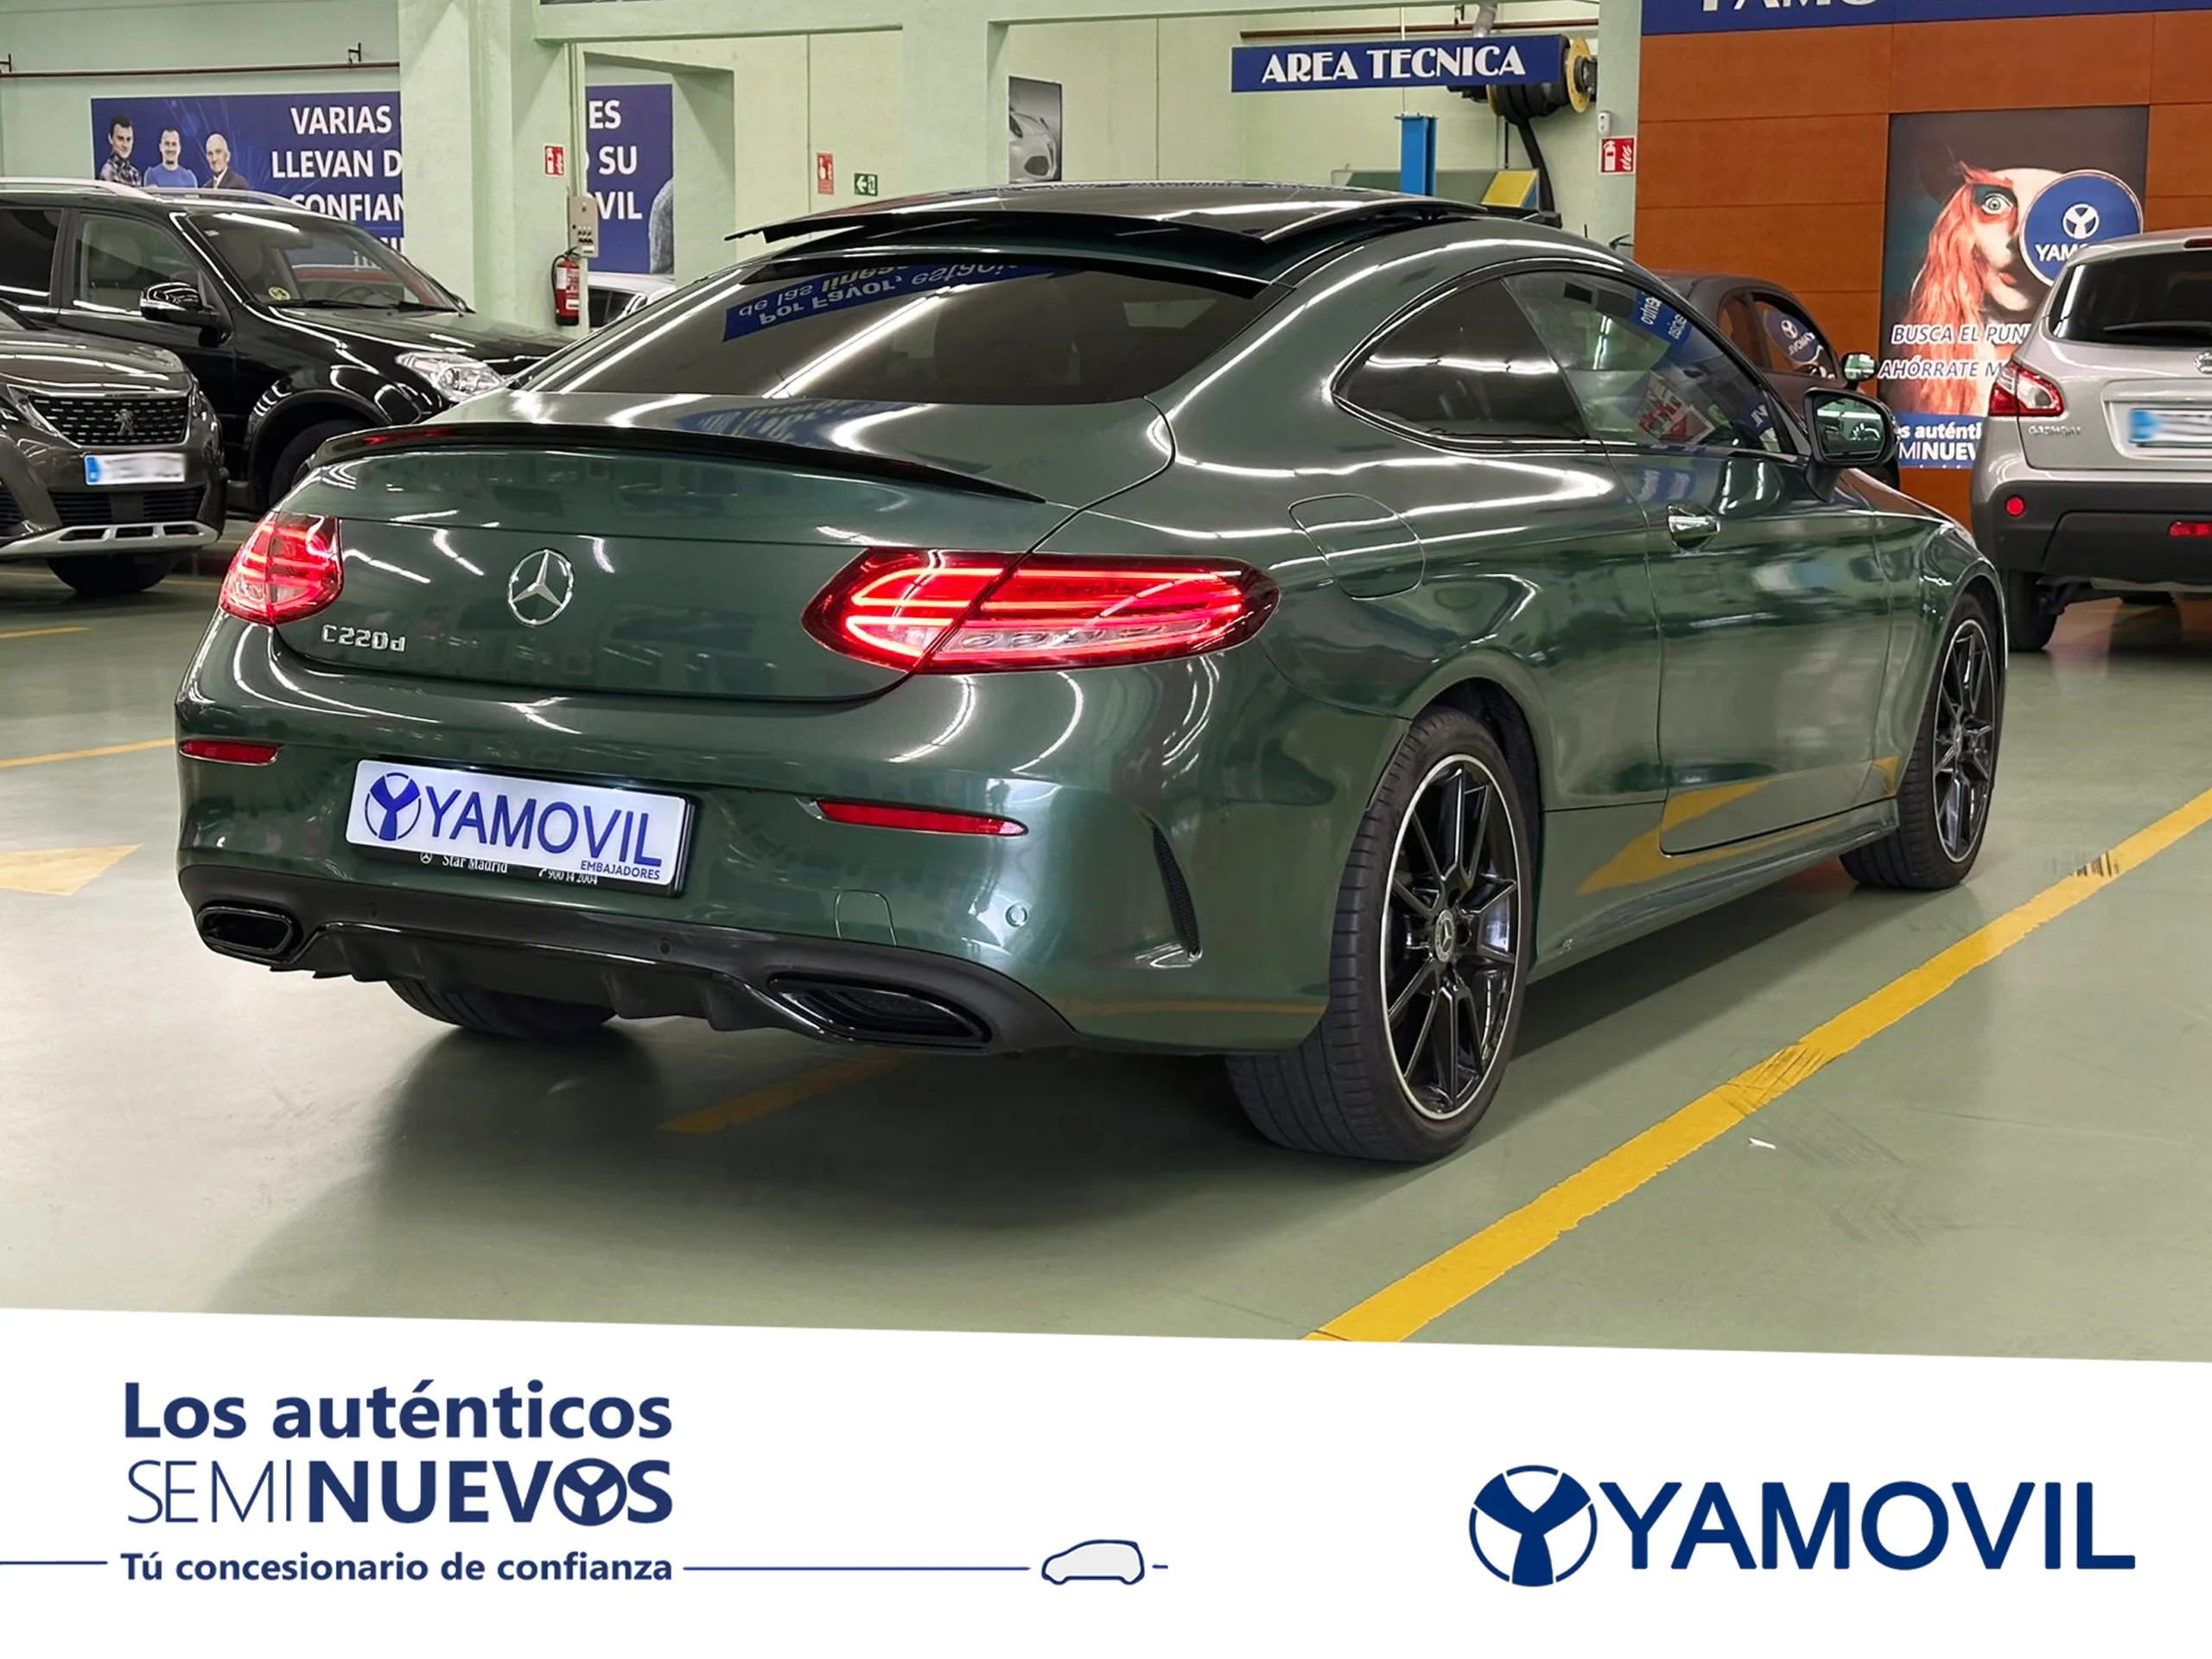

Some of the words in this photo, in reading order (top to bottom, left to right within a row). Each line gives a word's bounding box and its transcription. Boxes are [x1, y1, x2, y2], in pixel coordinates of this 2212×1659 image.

[1262, 51, 1358, 84] AREA
[1367, 45, 1525, 79] TECNICA
[290, 105, 392, 135] VARIAS
[271, 149, 373, 178] LLEVAN
[598, 145, 637, 175] SU
[588, 191, 643, 219] VIL
[2035, 243, 2088, 262] YAM
[1891, 323, 1953, 345] BUSCA
[1960, 323, 1981, 345] EL
[1878, 353, 1979, 378] AHÓRRATE
[321, 624, 406, 652] C220d
[425, 785, 662, 868] YAMOVIL
[580, 860, 660, 880] EMBAJADORES
